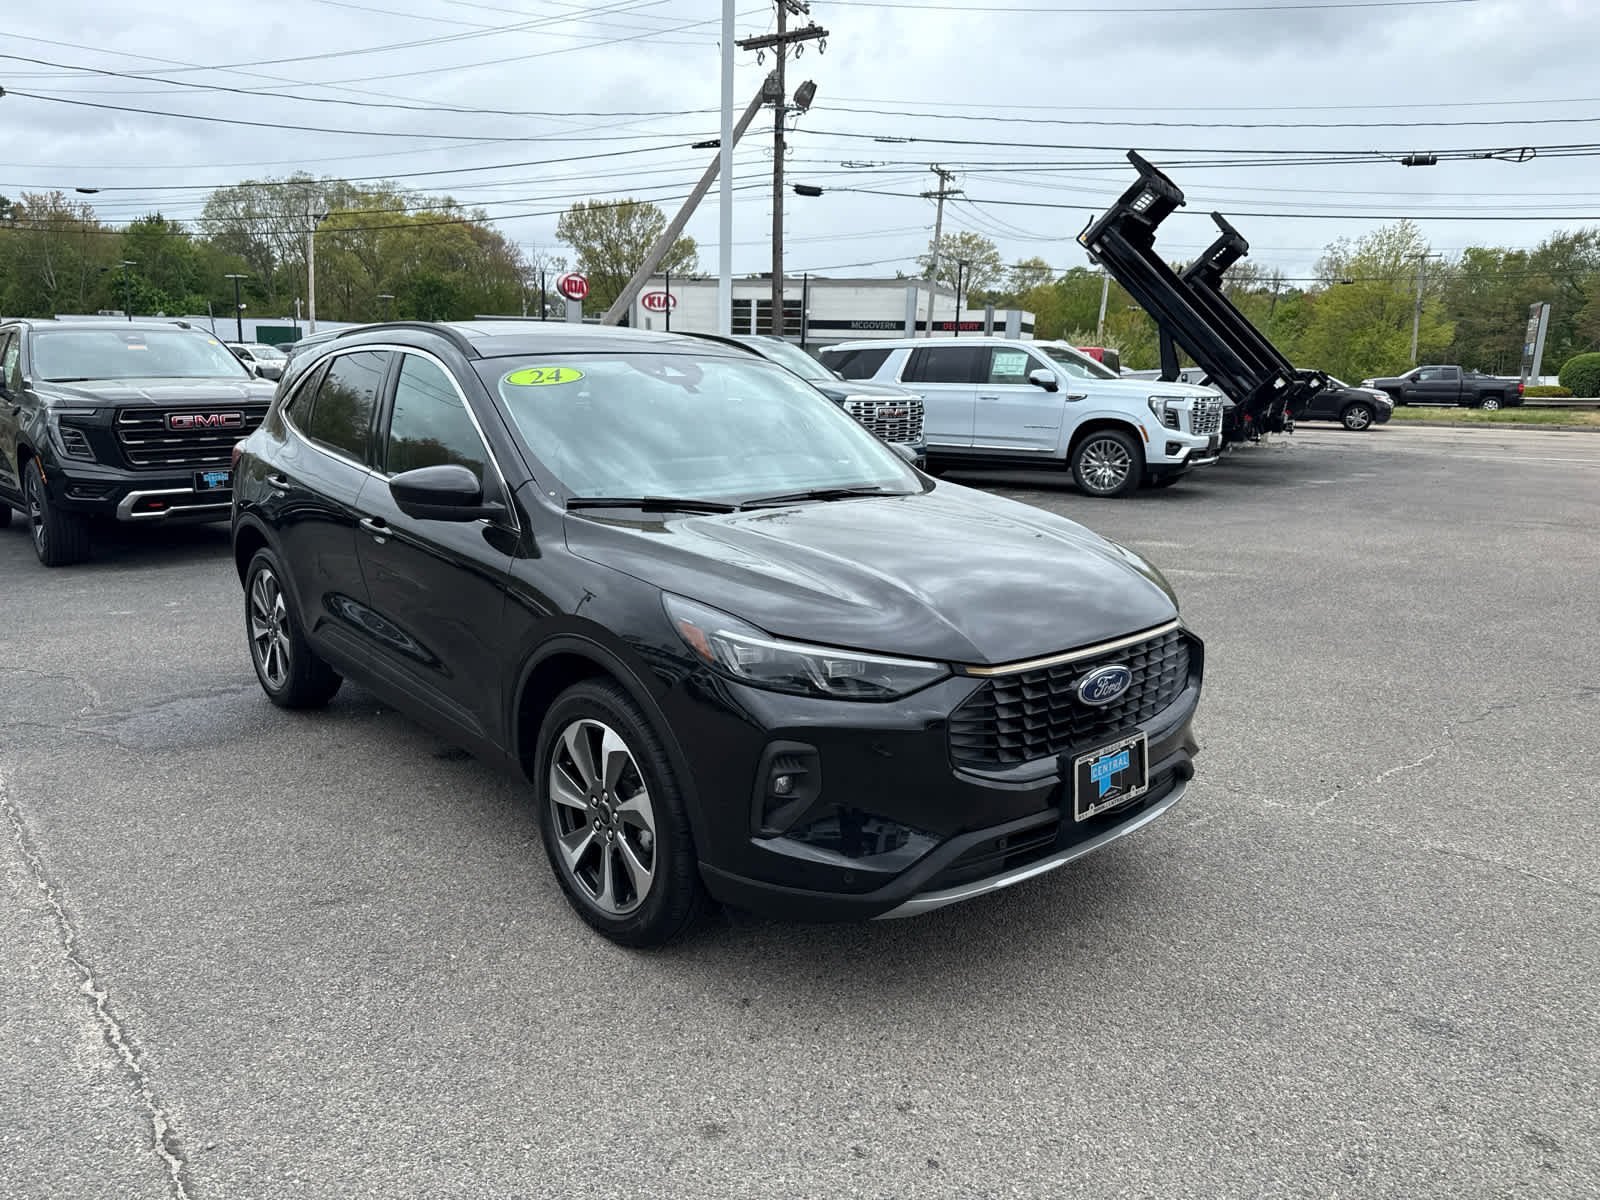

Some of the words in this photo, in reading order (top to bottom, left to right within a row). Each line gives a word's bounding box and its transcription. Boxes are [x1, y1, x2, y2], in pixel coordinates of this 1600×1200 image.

[851, 320, 896, 330] MCGOVERN
[943, 322, 979, 331] DELVERY
[530, 369, 562, 384] 24
[171, 413, 241, 429] GMC
[1093, 674, 1123, 698] Ford
[1091, 752, 1128, 777] CENTRAL
